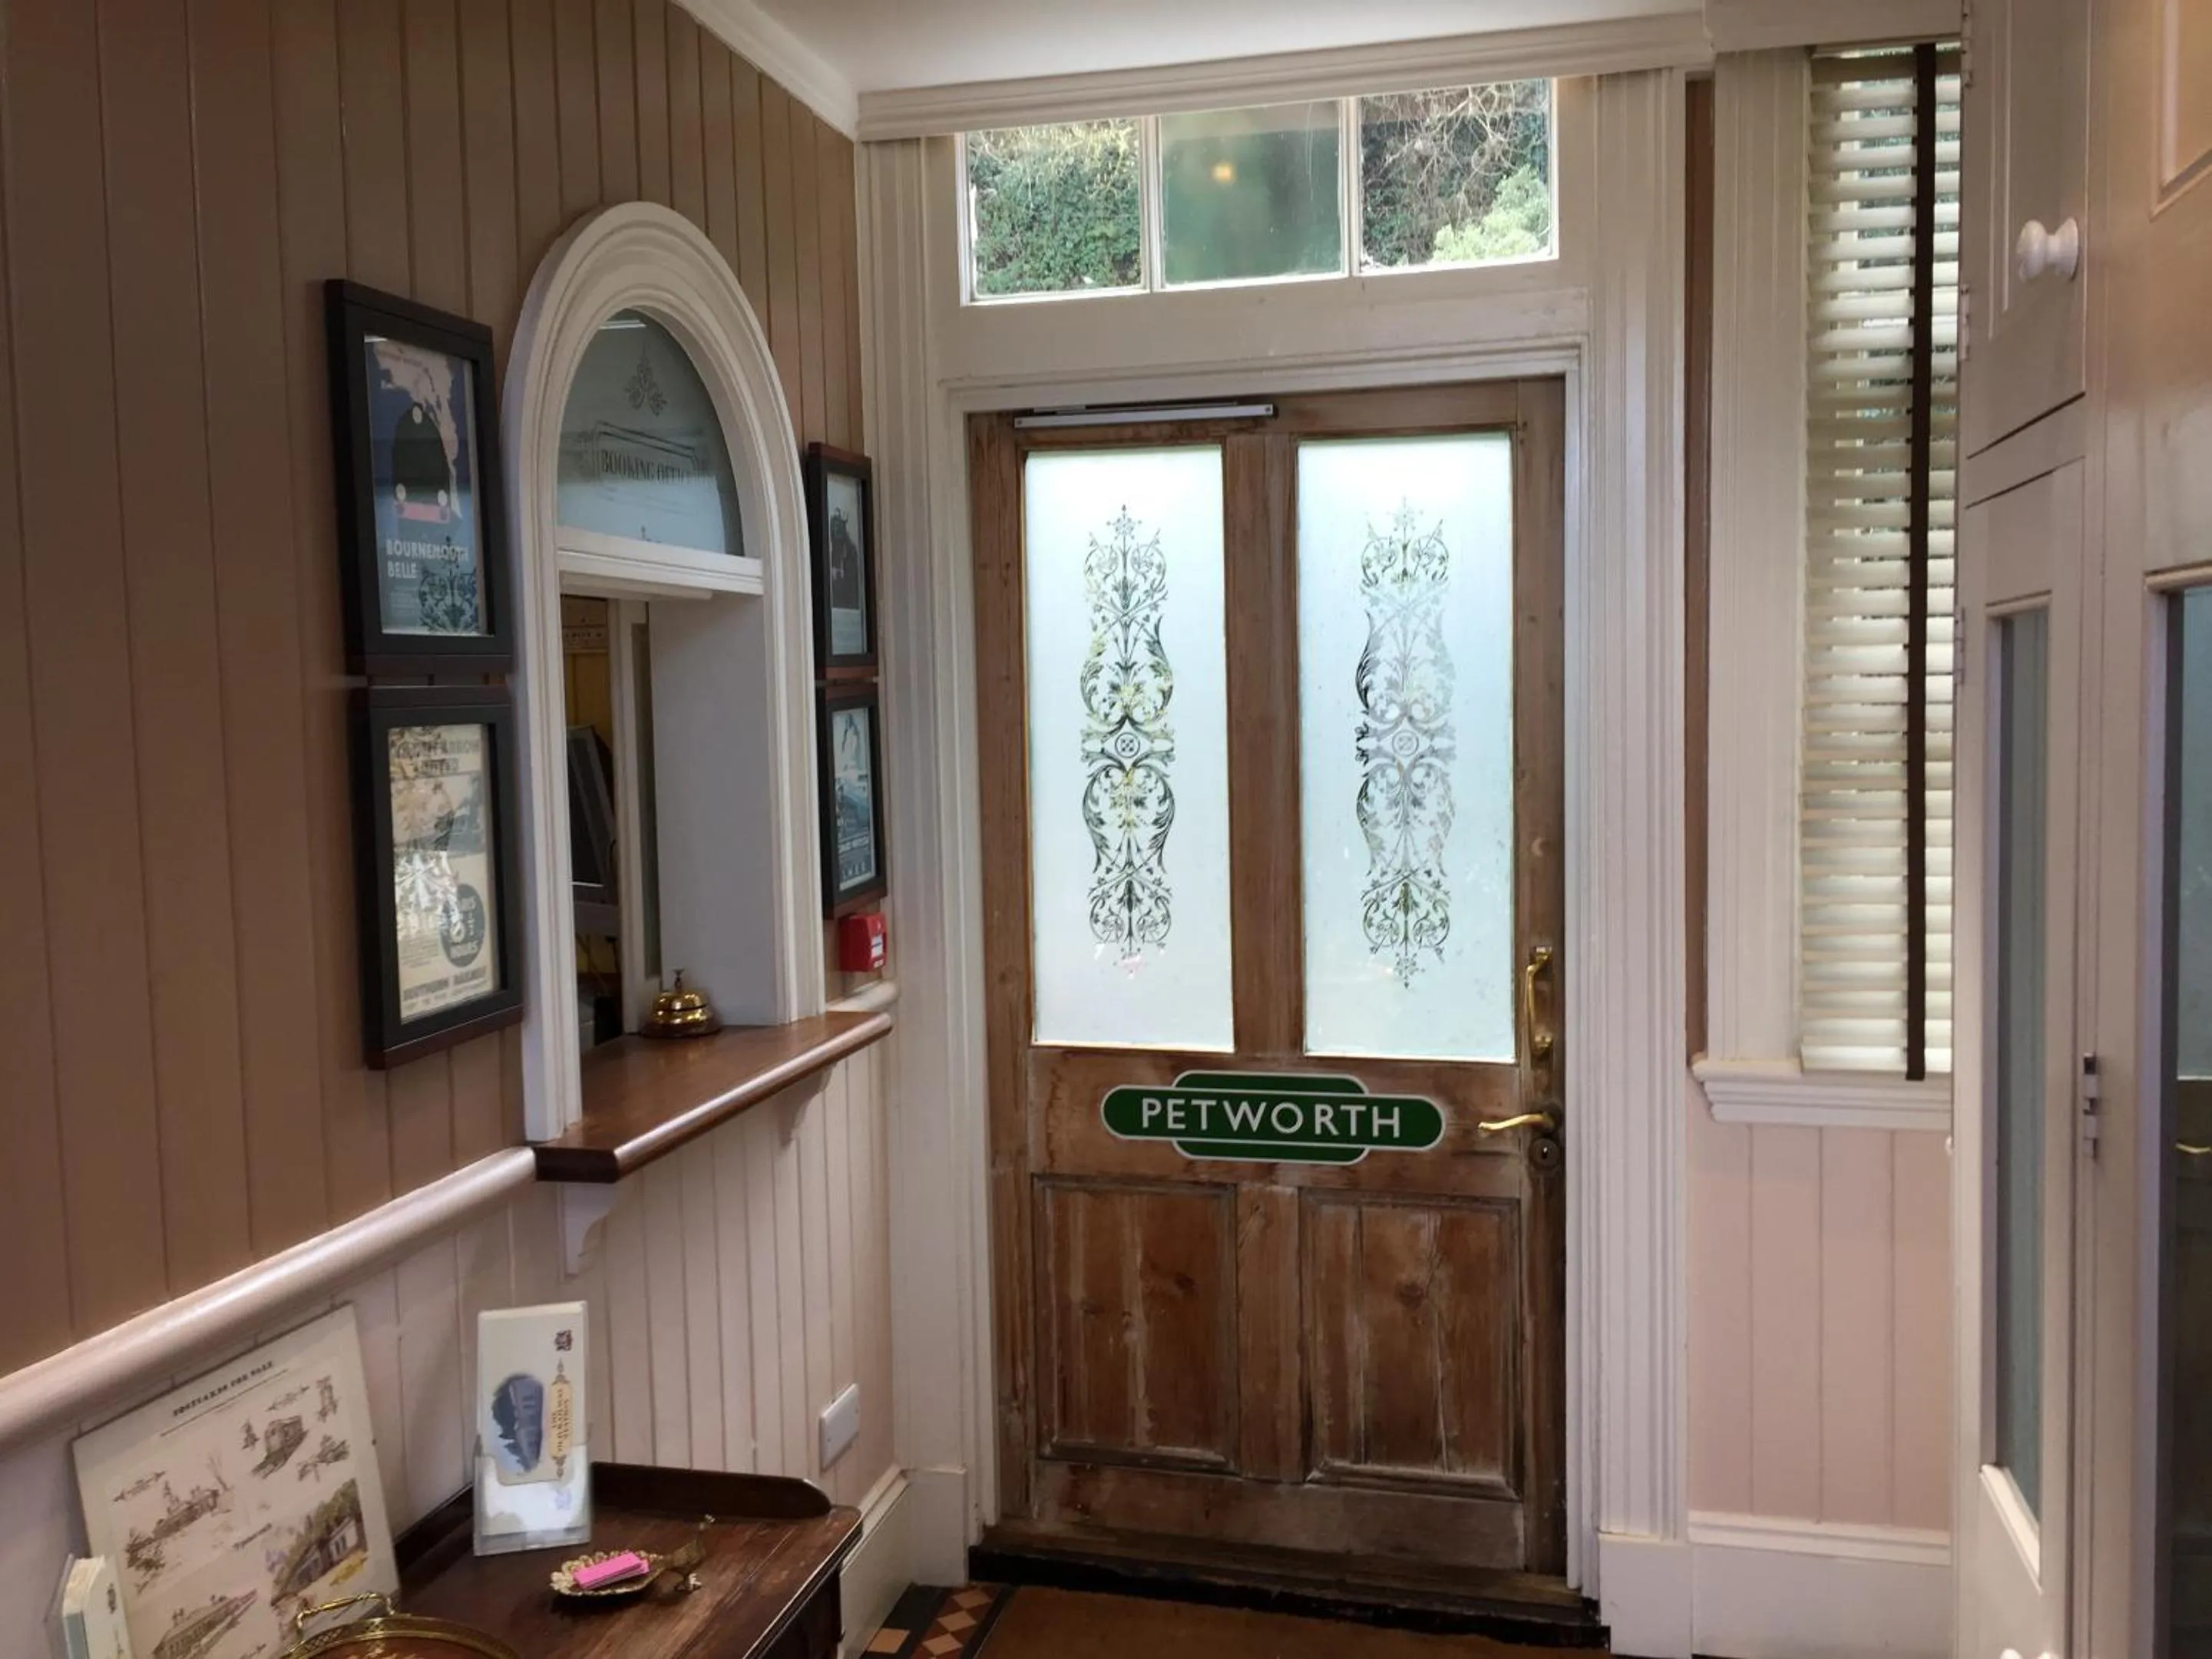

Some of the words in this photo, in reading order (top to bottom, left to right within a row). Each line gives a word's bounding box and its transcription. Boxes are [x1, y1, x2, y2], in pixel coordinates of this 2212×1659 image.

[385, 539, 470, 562] BOURNEMOUTH
[387, 560, 418, 579] BELLE
[1141, 1097, 1401, 1138] PETWORTH
